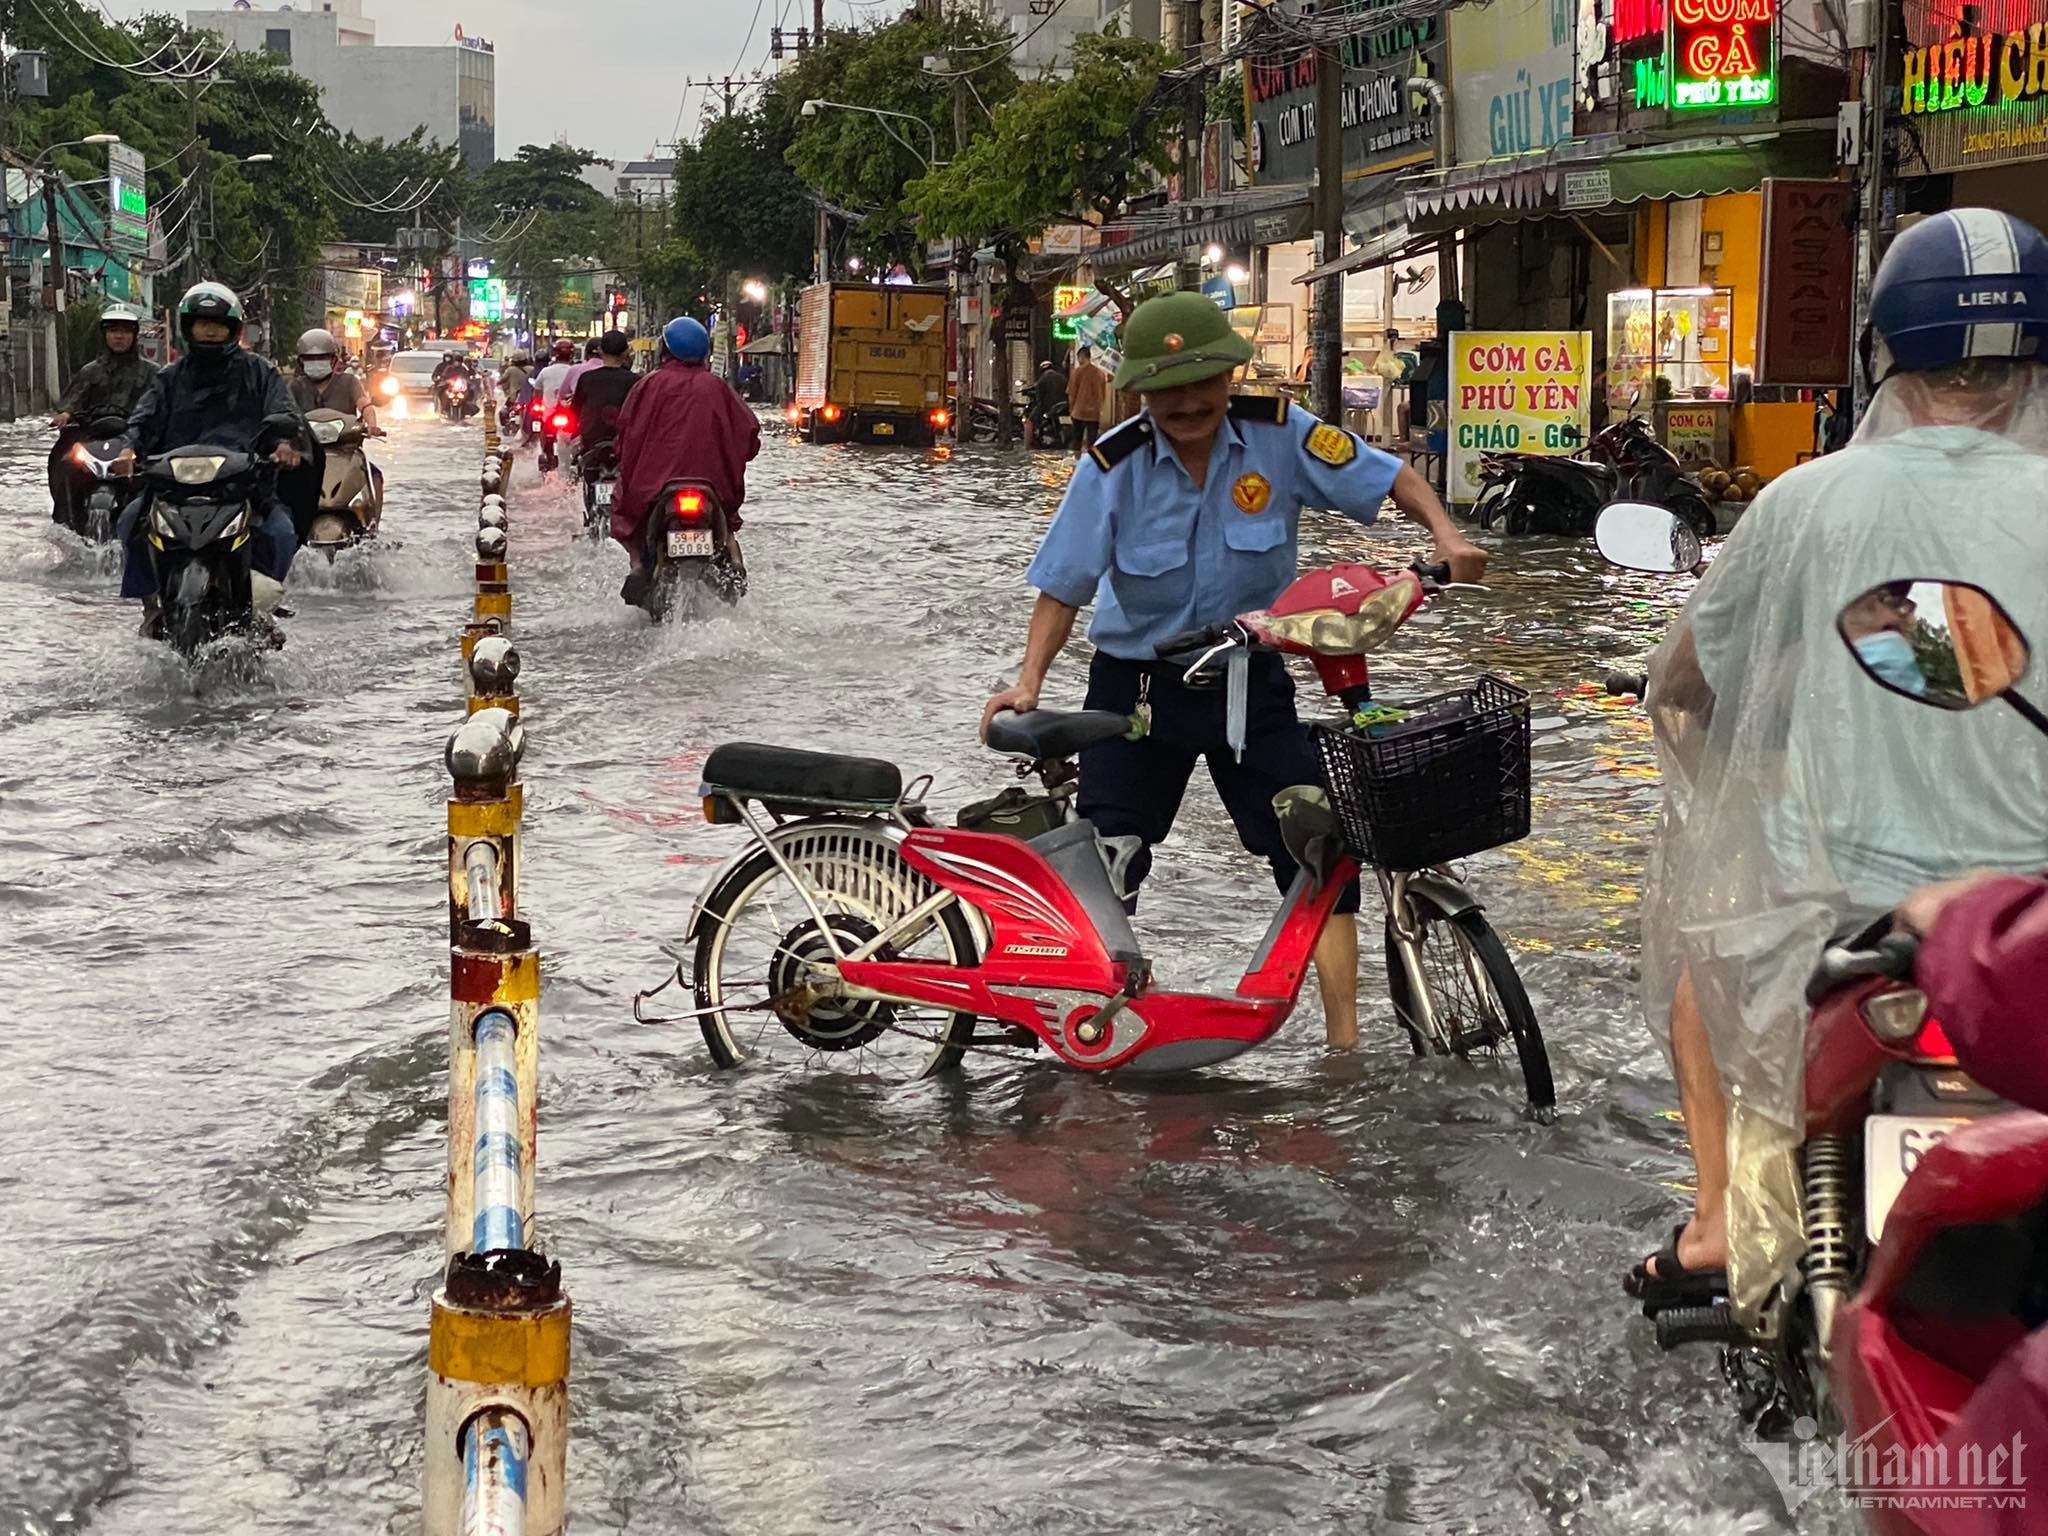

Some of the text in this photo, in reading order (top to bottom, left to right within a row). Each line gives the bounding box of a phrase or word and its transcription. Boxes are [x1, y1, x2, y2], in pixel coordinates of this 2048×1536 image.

[1689, 24, 1757, 75] GÀ
[1676, 75, 1770, 104] PHÚ YÊN
[1538, 77, 1572, 147] XE
[1958, 291, 2027, 307] LIEN A
[1468, 342, 1526, 372] CƠM
[1535, 340, 1573, 372] GÀ
[1461, 377, 1580, 410] PHÚ YÊN
[1458, 419, 1519, 449] CHÁO
